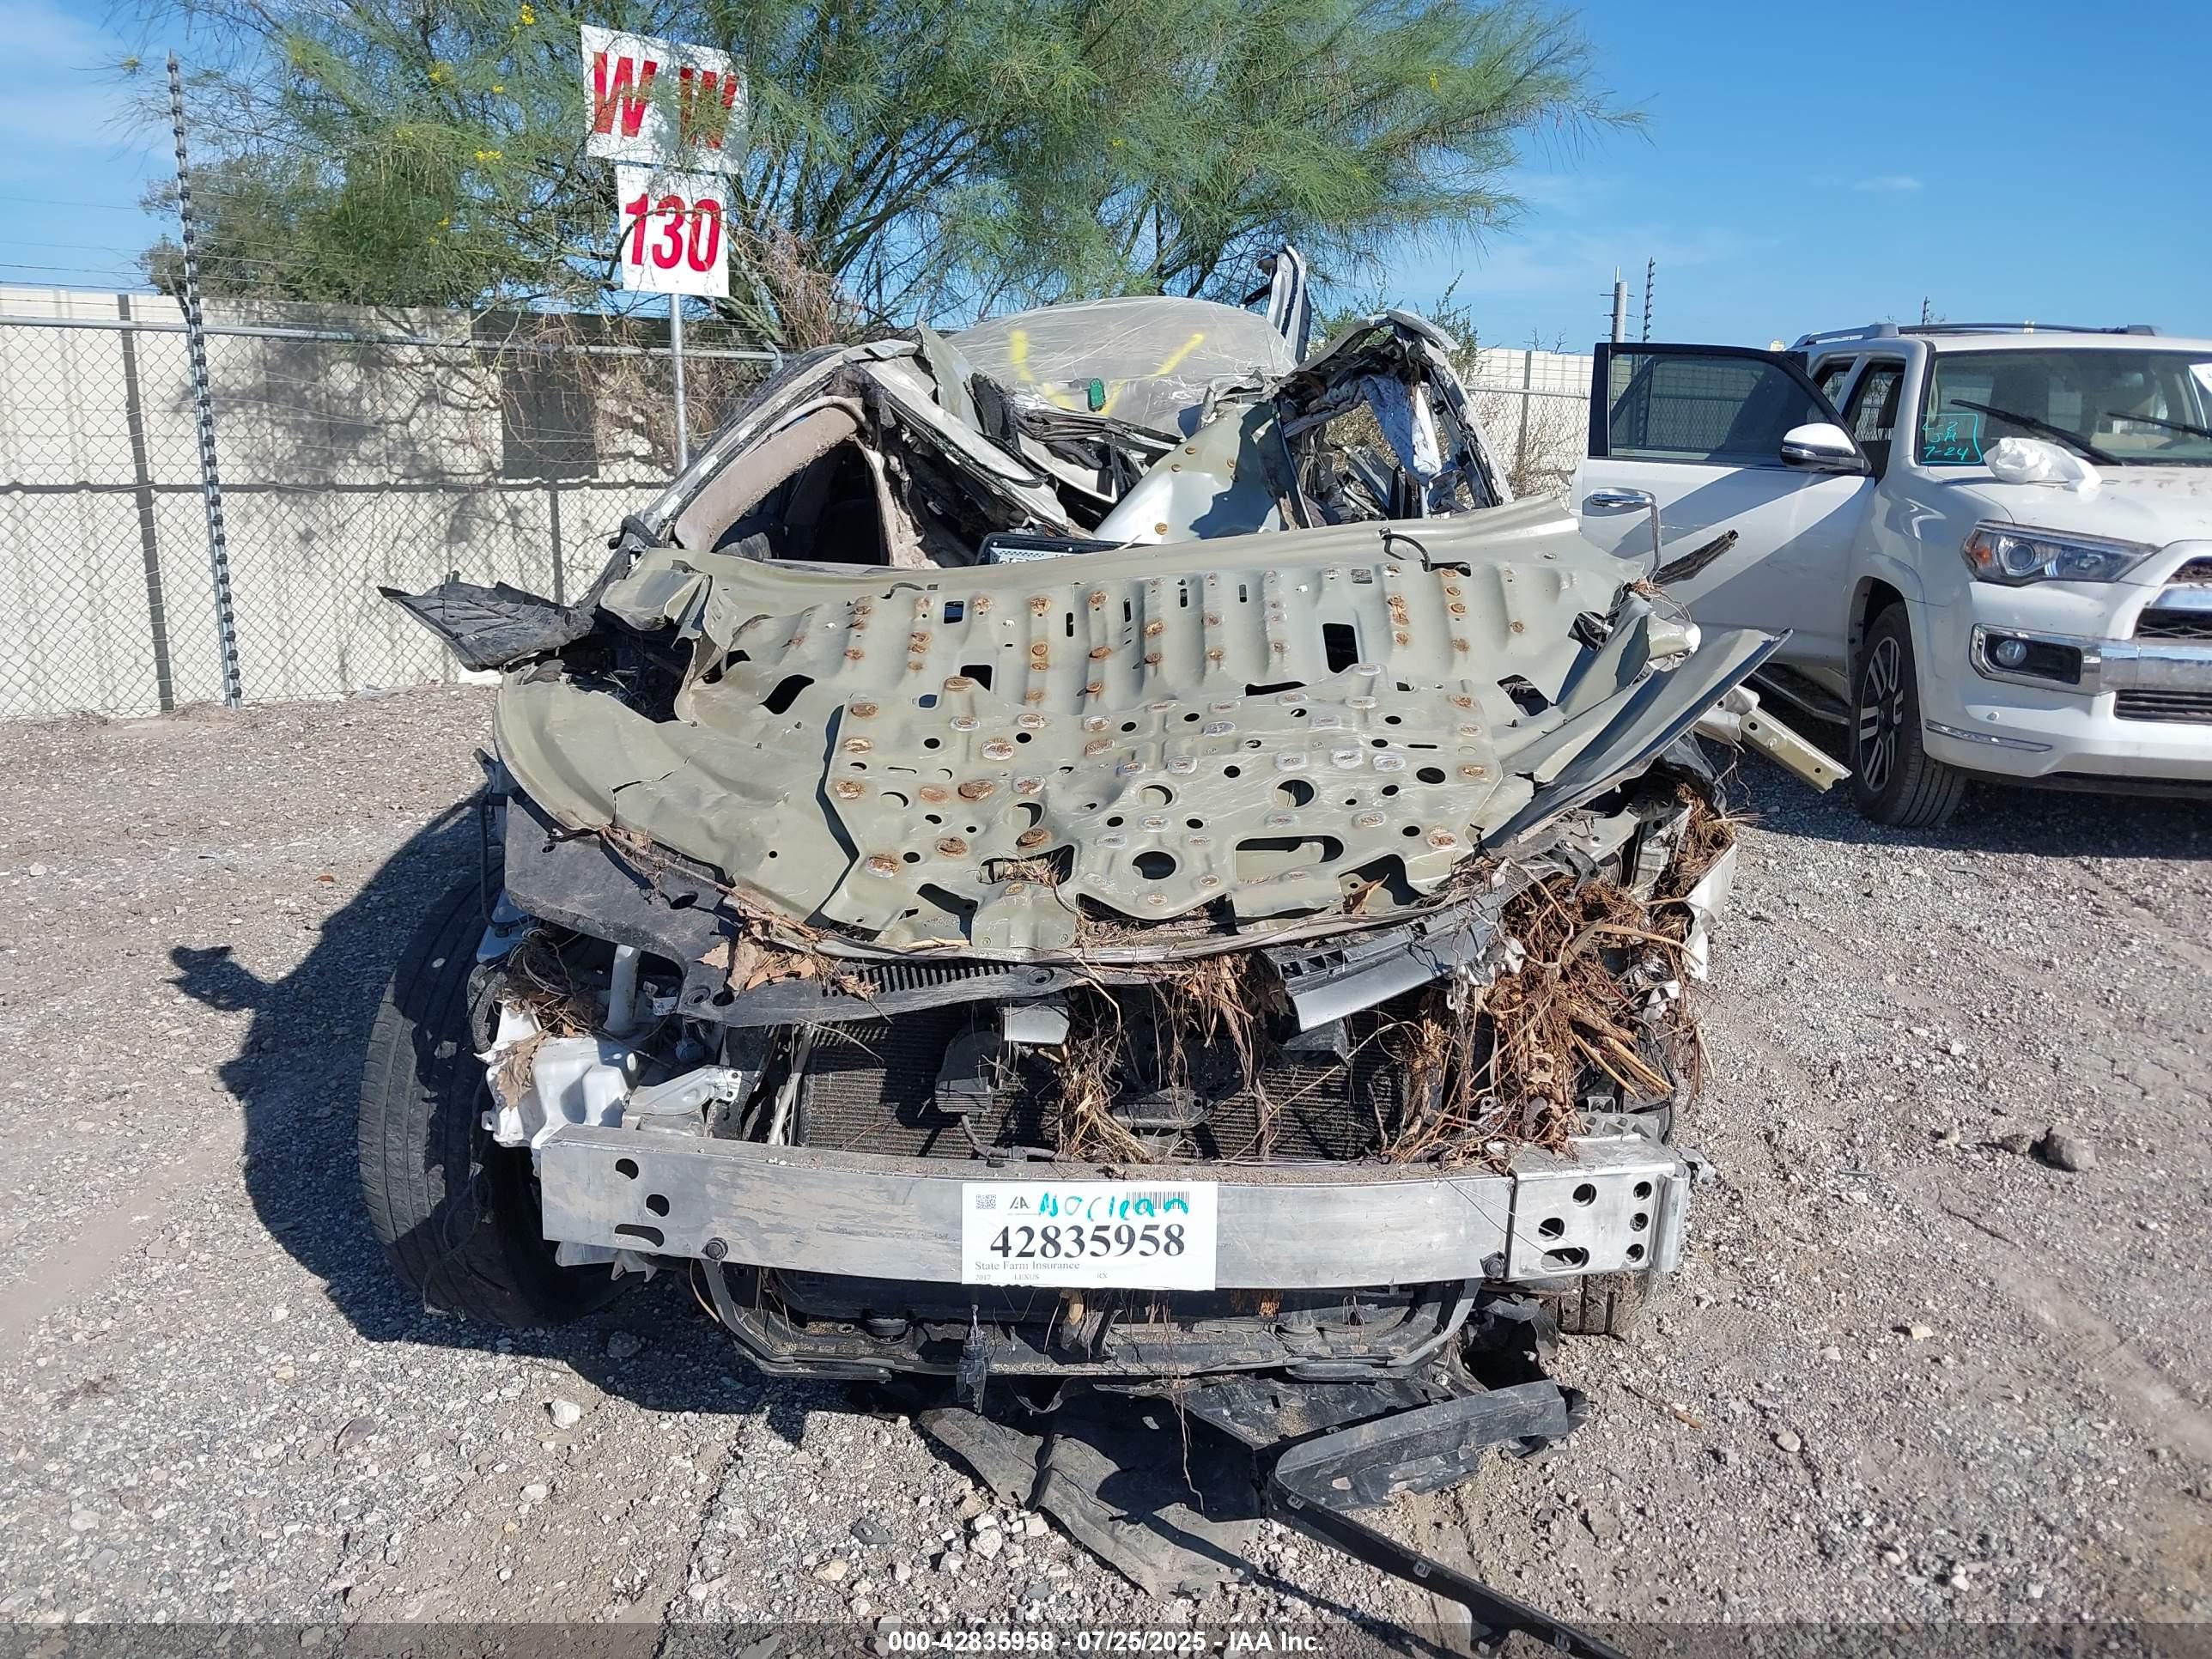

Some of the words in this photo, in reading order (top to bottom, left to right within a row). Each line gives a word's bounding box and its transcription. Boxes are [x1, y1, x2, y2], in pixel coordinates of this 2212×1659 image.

[625, 192, 722, 272] 130
[1923, 446, 1969, 461] 7-24
[990, 1224, 1185, 1259] 42835958
[975, 1261, 1000, 1270] State
[1003, 1261, 1029, 1270] Farm
[1032, 1260, 1080, 1270] Insurance
